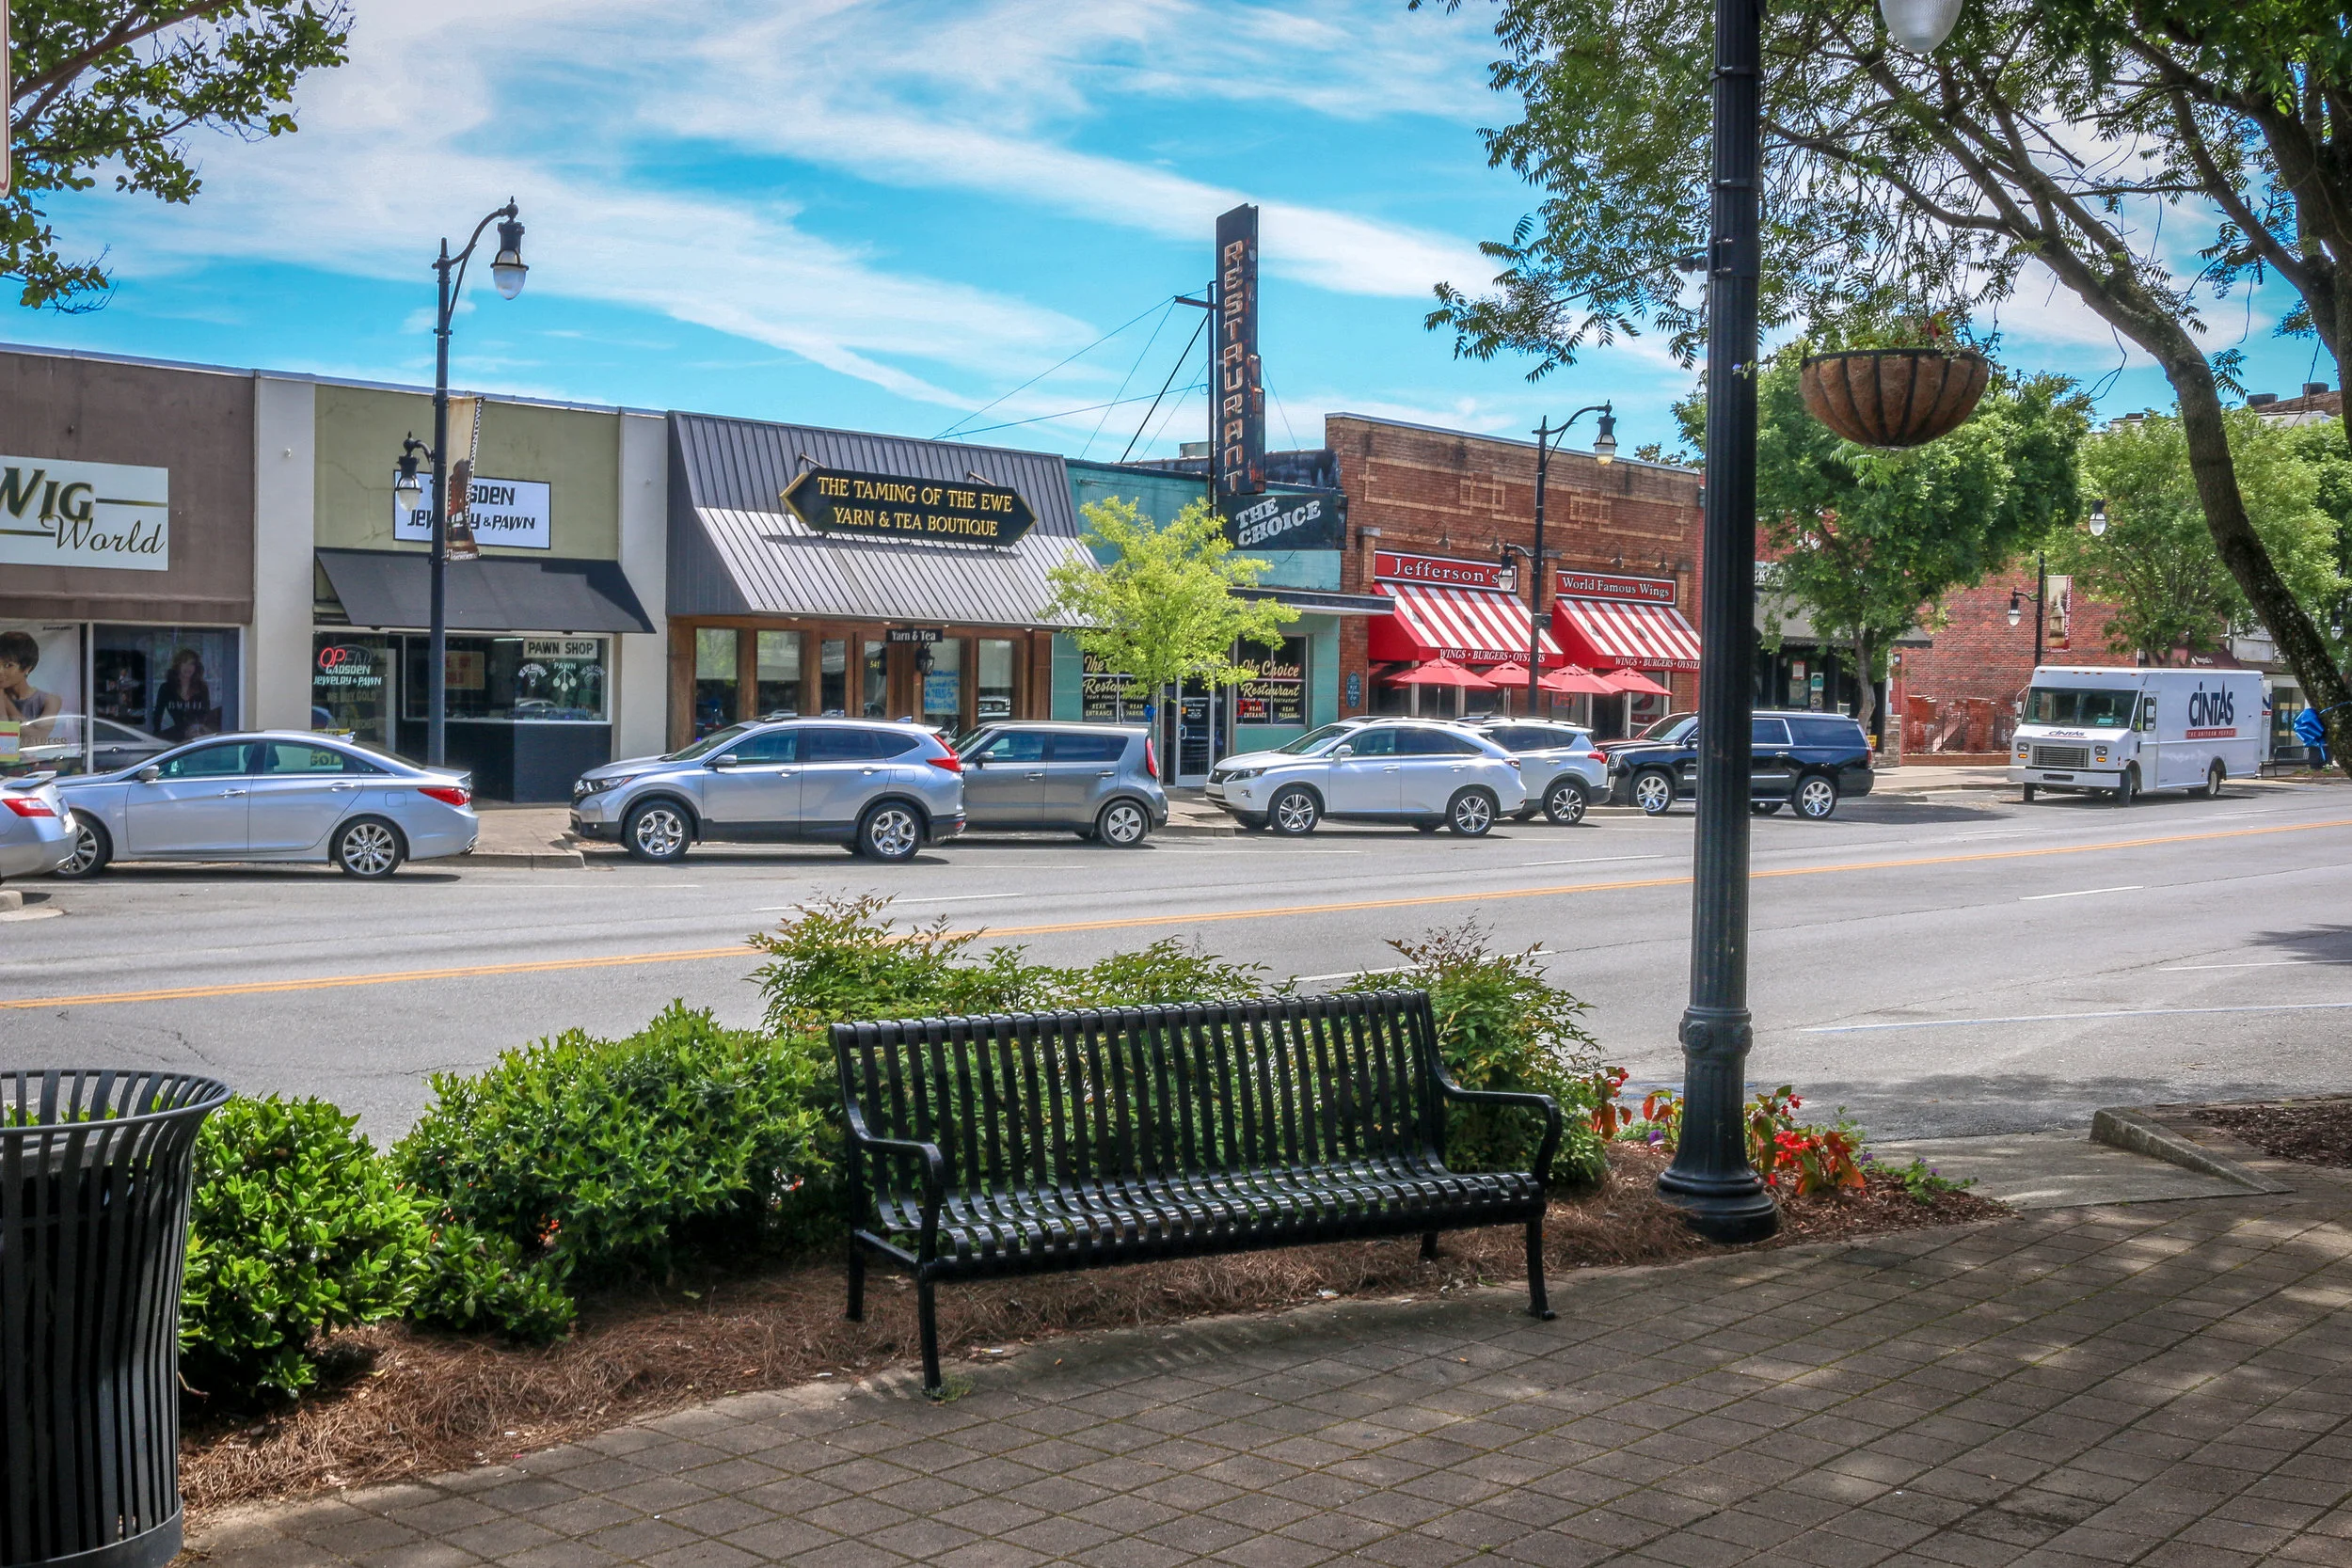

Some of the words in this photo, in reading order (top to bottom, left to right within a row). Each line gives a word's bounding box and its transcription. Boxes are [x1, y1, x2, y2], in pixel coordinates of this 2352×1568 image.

[1224, 240, 1244, 492] RESTAURANT
[818, 476, 850, 497] THE
[853, 480, 916, 503] TAMING
[921, 486, 943, 506] OF
[947, 490, 976, 509] THE
[980, 494, 1012, 513] EWE
[834, 507, 874, 526] YARN
[879, 512, 890, 528] &
[894, 513, 923, 531] TEA
[928, 516, 998, 536] BOUTIQUE
[1235, 497, 1279, 530] THE
[483, 517, 491, 528] &
[491, 515, 535, 531] PAWN
[1238, 500, 1321, 546] CHOICE
[40, 515, 166, 554] World
[1393, 558, 1499, 584] Jefferson's
[1562, 577, 1595, 591] World
[1597, 579, 1636, 594] Famous
[1639, 583, 1669, 598] Wings
[892, 631, 911, 641] Yarn
[912, 631, 918, 641] &
[921, 631, 936, 641] Tea
[528, 641, 560, 655] PAWN
[564, 642, 594, 655] SHOP
[1439, 648, 1466, 659] WINGS
[1472, 650, 1509, 661] BURGERS
[1513, 652, 1546, 663] OYSTRS
[326, 664, 372, 675] GADSDEN
[1084, 655, 1104, 672] The
[1262, 659, 1299, 677] Choice
[1615, 657, 1638, 666] WINGS
[1643, 658, 1674, 668] BURGERS
[358, 676, 382, 688] PAWN
[1241, 682, 1300, 697] Restaurant
[2188, 680, 2234, 727] CINTAS
